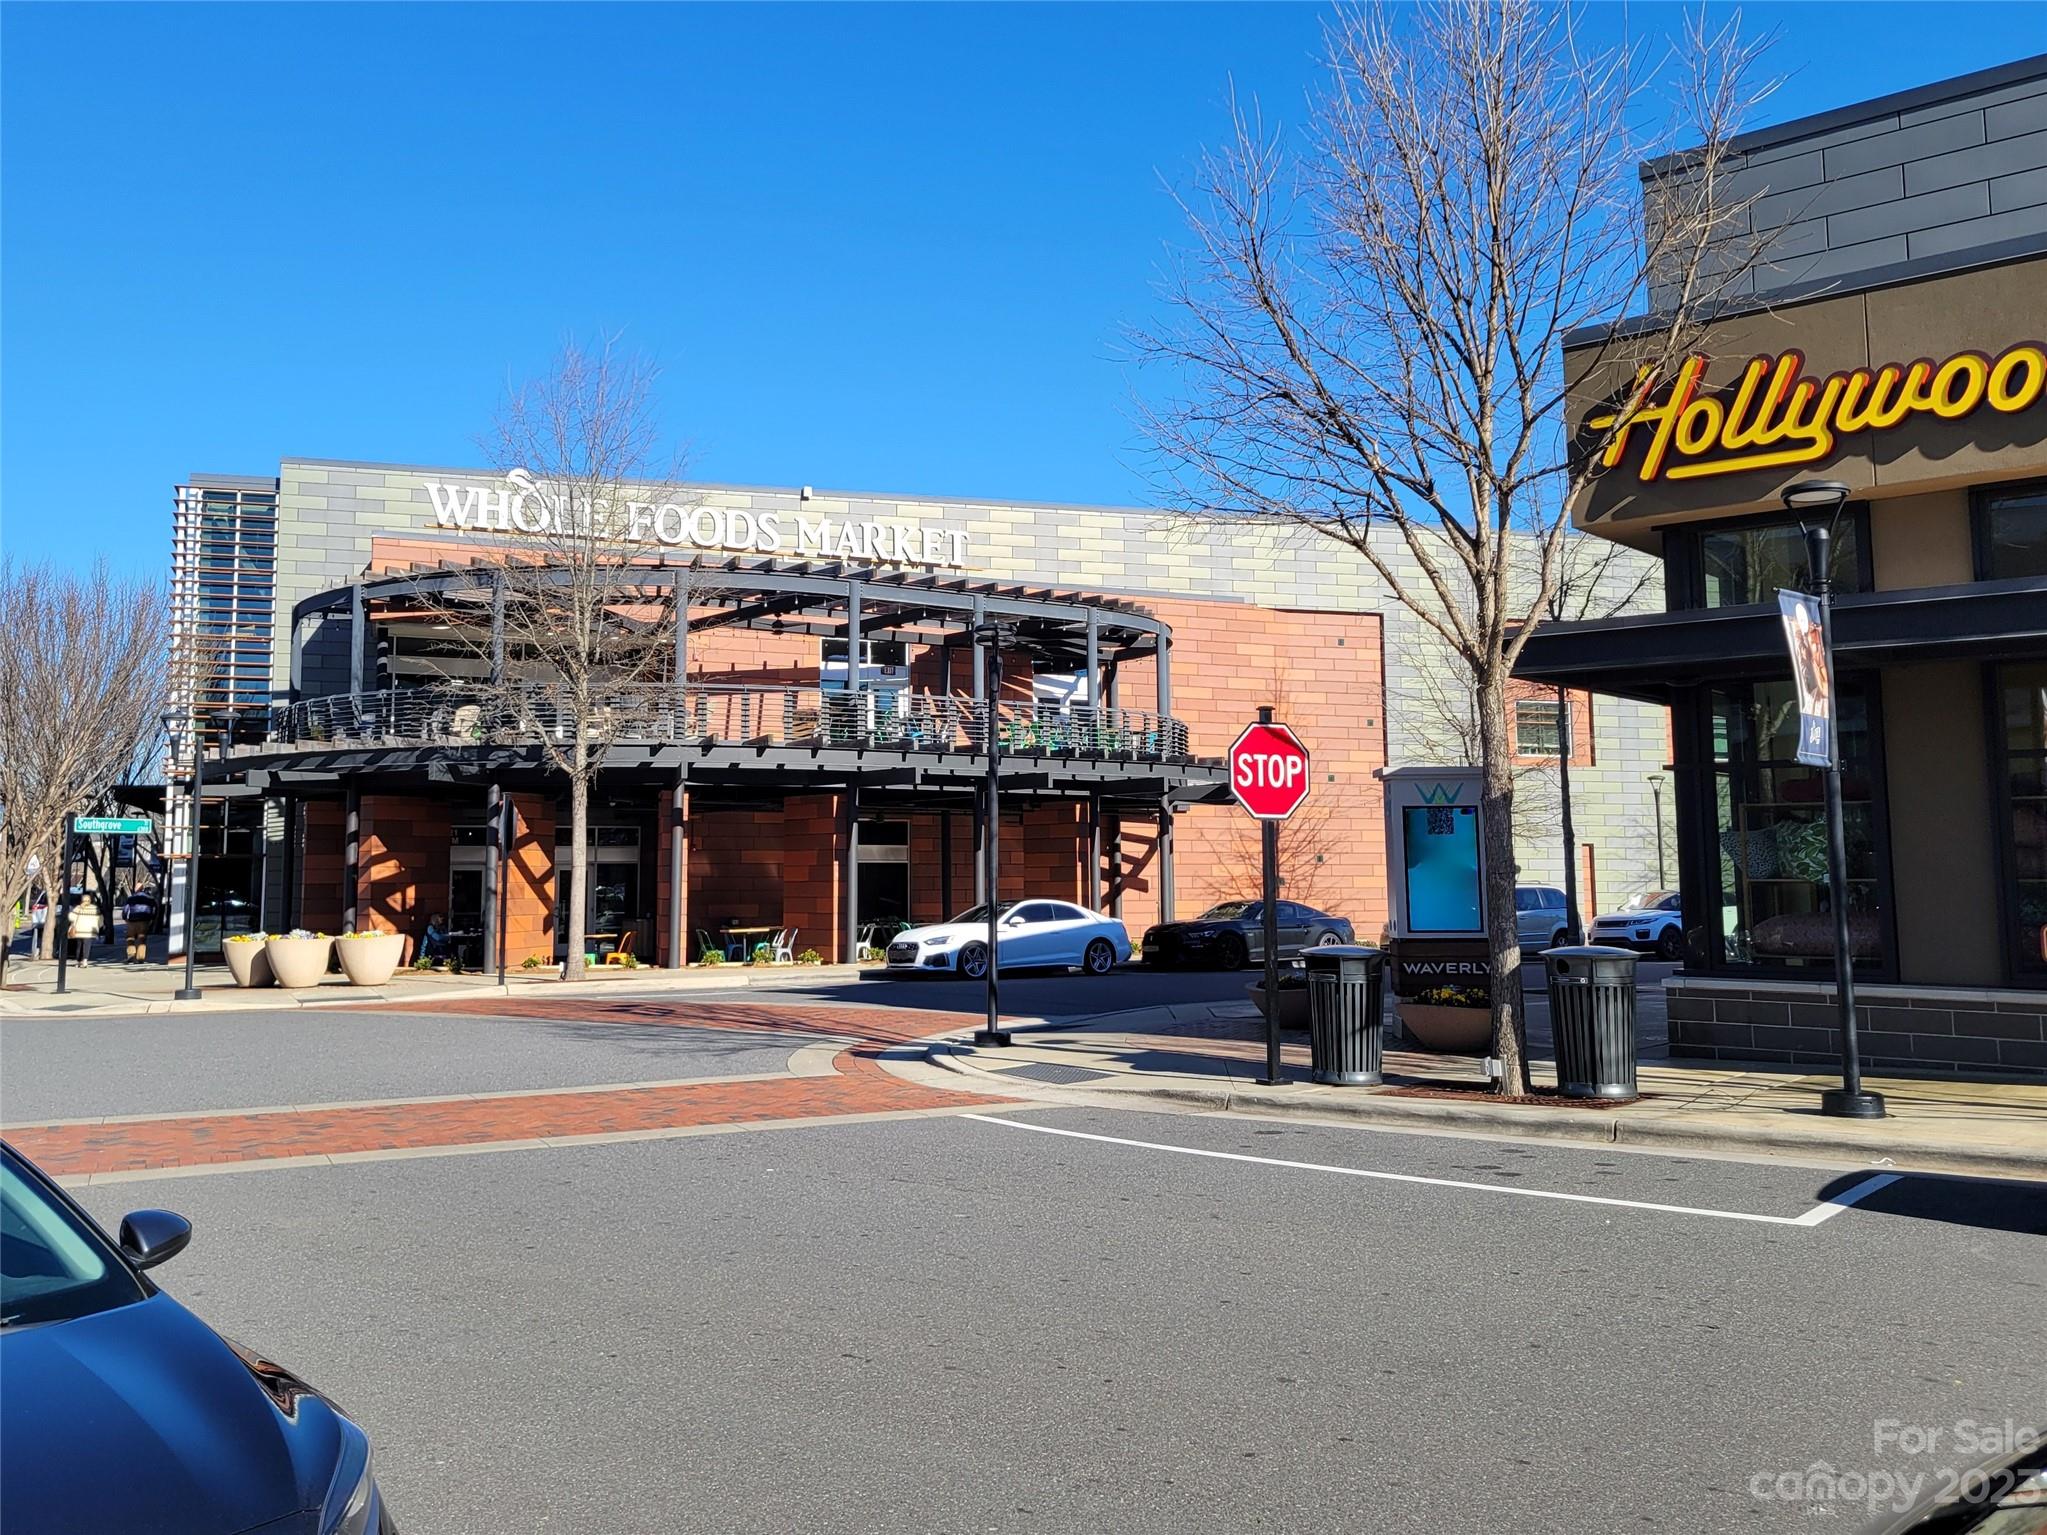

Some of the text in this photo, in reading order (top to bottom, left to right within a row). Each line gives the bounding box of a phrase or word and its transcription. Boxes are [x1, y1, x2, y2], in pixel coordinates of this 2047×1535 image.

[424, 474, 970, 566] WHOLE FOODS MARKET
[1237, 753, 1302, 788] STOP
[78, 819, 122, 832] Southgrove
[1403, 962, 1492, 974] WAVERLY
